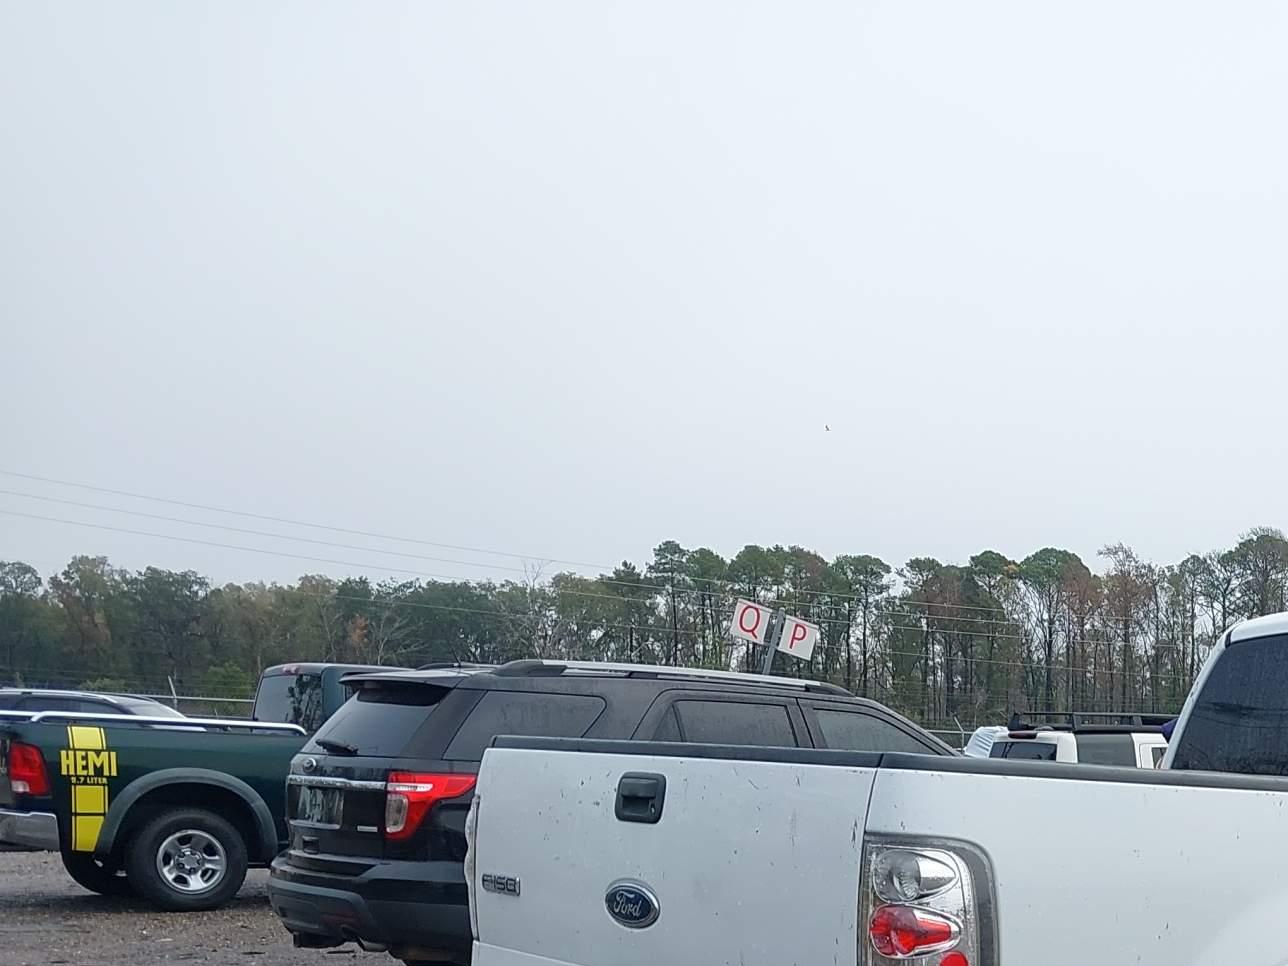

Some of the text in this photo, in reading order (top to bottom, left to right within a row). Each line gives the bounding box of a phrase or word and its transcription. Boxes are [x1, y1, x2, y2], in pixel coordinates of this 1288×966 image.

[738, 604, 761, 640] Q
[789, 622, 807, 650] P
[60, 749, 118, 777] HEMI
[86, 777, 108, 785] LITER
